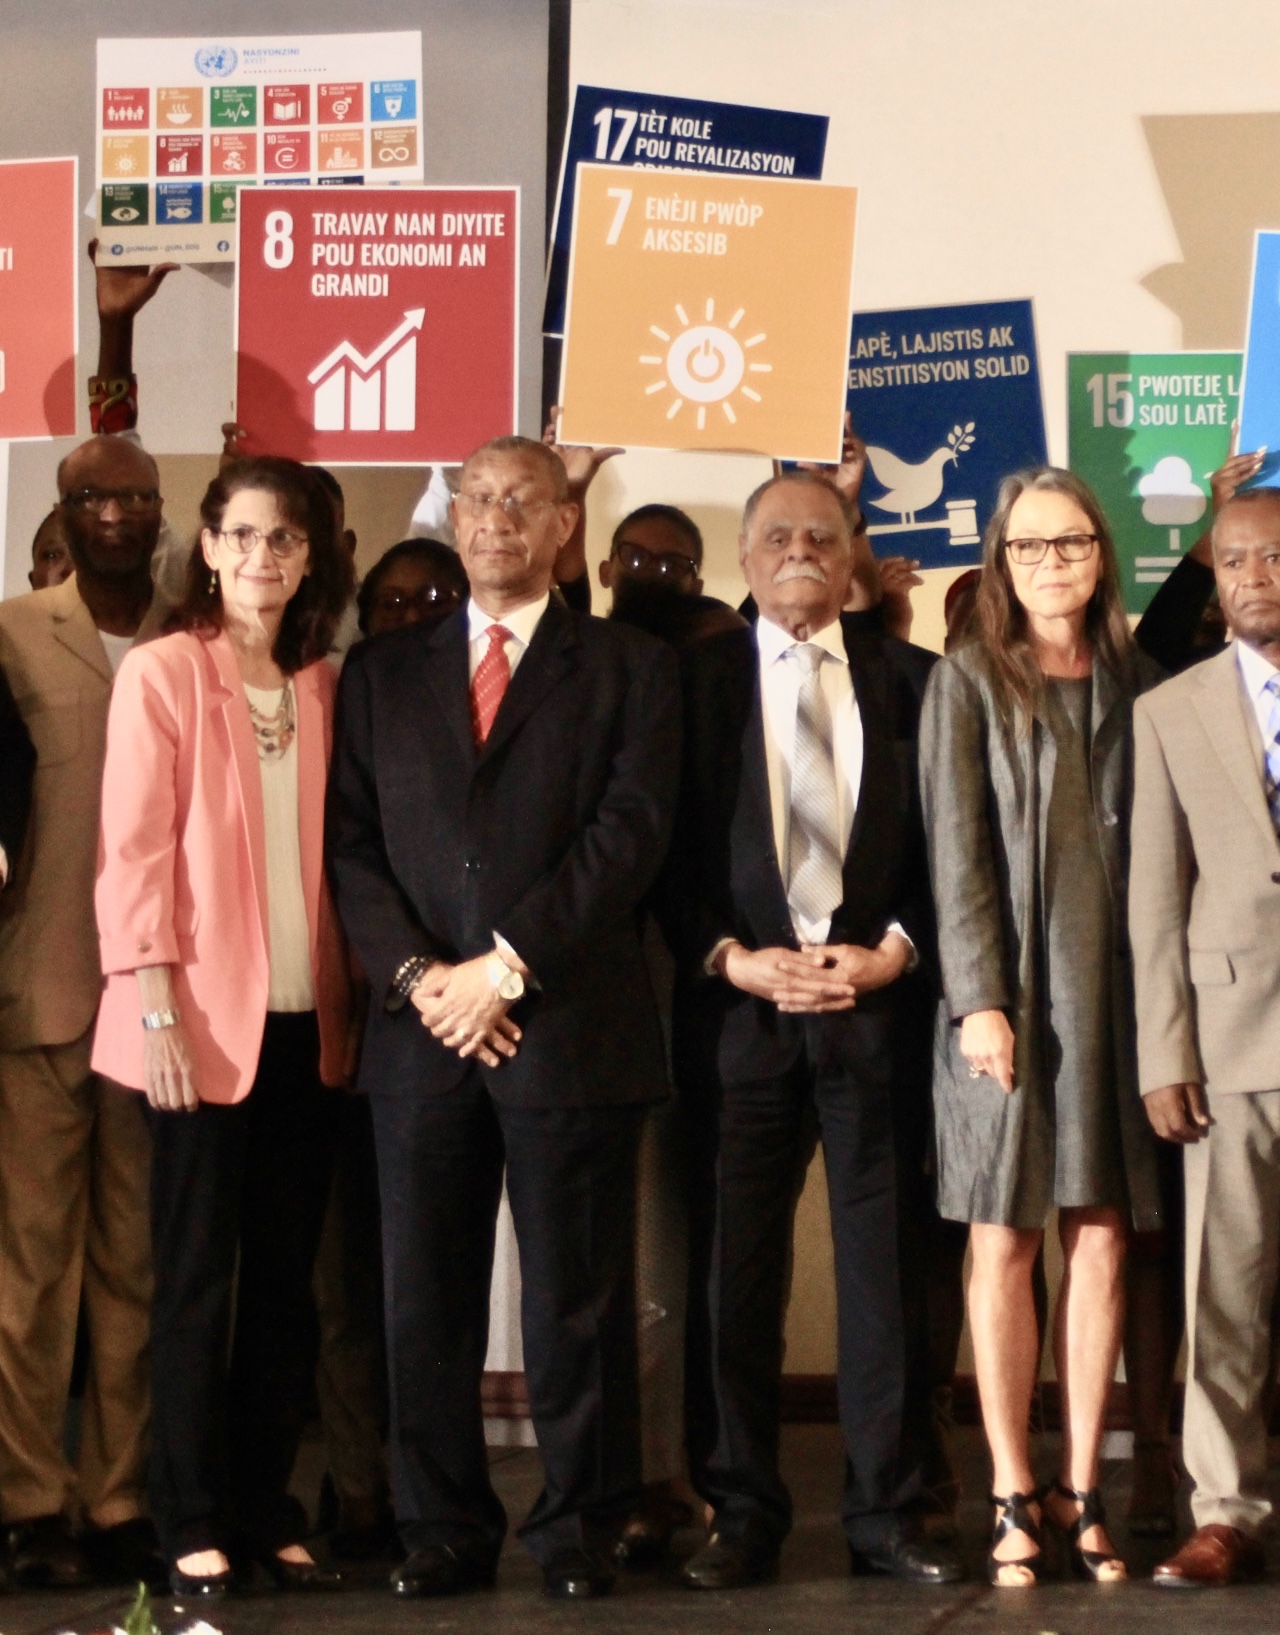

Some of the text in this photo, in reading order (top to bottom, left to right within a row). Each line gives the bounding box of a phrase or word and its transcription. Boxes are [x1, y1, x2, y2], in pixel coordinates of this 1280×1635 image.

[320, 86, 327, 96] 5
[594, 107, 638, 161] 17
[639, 109, 713, 140] TÈT KOLE
[635, 138, 671, 159] POU
[675, 143, 795, 176] REYALIZASYON
[312, 213, 505, 236] TRAVAY NAN DIYITE
[606, 188, 633, 245] 7
[646, 192, 763, 227] ENÈJI PWÒP
[263, 210, 294, 269] 8
[642, 228, 728, 256] AKSESIB
[312, 243, 486, 267] POU EKONOMI AN
[311, 274, 388, 297] GRANDI
[901, 329, 983, 355] LAJISTIS
[988, 326, 1014, 348] AK
[848, 355, 1030, 390] ENSTITISYON SOLID
[1139, 375, 1222, 397] PWOTEJE
[1086, 373, 1134, 428] 15
[1139, 397, 1227, 426] SOU LATÈ
